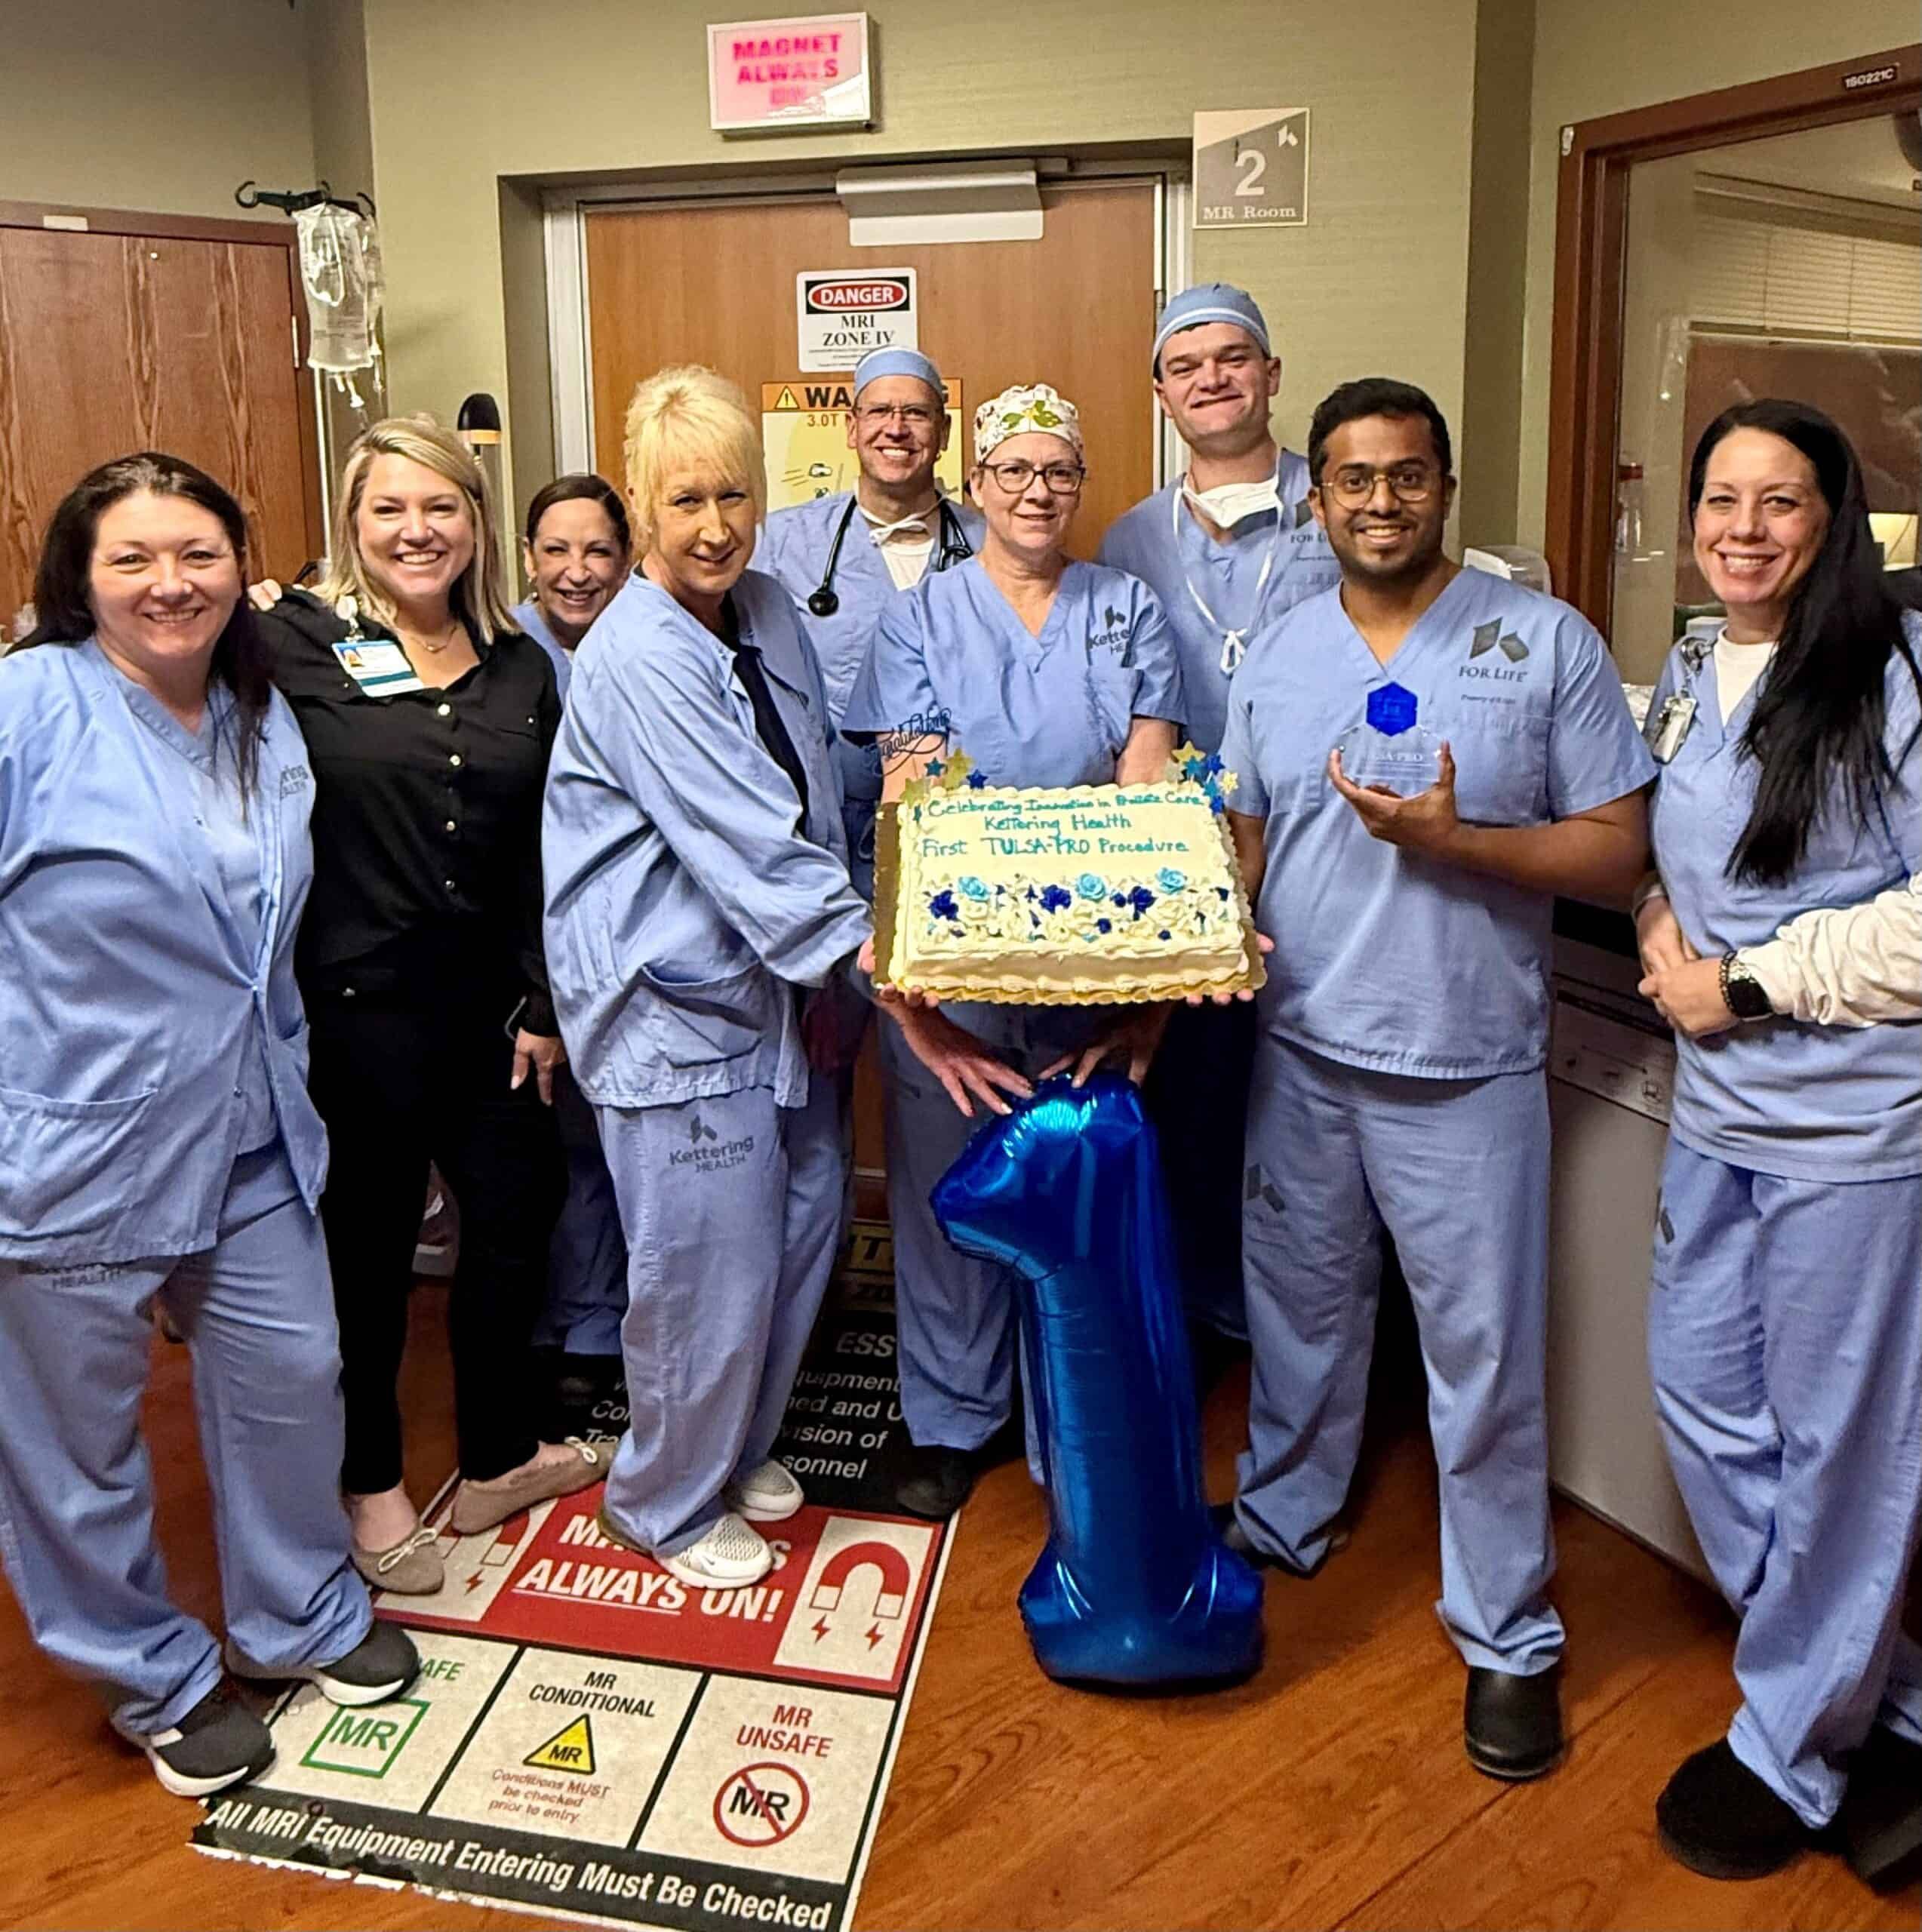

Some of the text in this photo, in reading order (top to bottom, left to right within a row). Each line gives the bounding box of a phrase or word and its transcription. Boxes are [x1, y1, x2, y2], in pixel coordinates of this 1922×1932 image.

[732, 34, 841, 60] MAGNET
[1235, 149, 1266, 196] 2
[1202, 205, 1296, 220] MR Room
[820, 286, 894, 304] DANGER
[841, 314, 875, 328] MRI
[823, 330, 896, 346] ZONE IV
[807, 414, 839, 427] 3.0T
[1459, 666, 1490, 678] FOR
[1165, 791, 1205, 805] Care
[984, 813, 1132, 836] Kettering Health
[922, 838, 968, 857] First
[1098, 837, 1189, 854] Procedure
[669, 1135, 754, 1166] Kettering
[695, 1153, 746, 1173] HEALTH
[832, 1400, 881, 1419] and
[860, 1430, 889, 1449] of
[516, 1558, 785, 1623] ALWAYS ON!
[421, 1659, 466, 1681] AFE
[583, 1671, 618, 1690] MR
[529, 1684, 656, 1718] CONDITIONAL
[773, 1704, 813, 1727] MR
[328, 1715, 399, 1752] MR
[736, 1724, 834, 1758] UNSAFE
[548, 1744, 583, 1764] MR
[492, 1768, 611, 1799] Conditions MUST
[503, 1786, 584, 1808] be checked
[487, 1798, 580, 1824] prior to entry
[205, 1800, 832, 1931] All MRI Equipment Entering Must Be Checked
